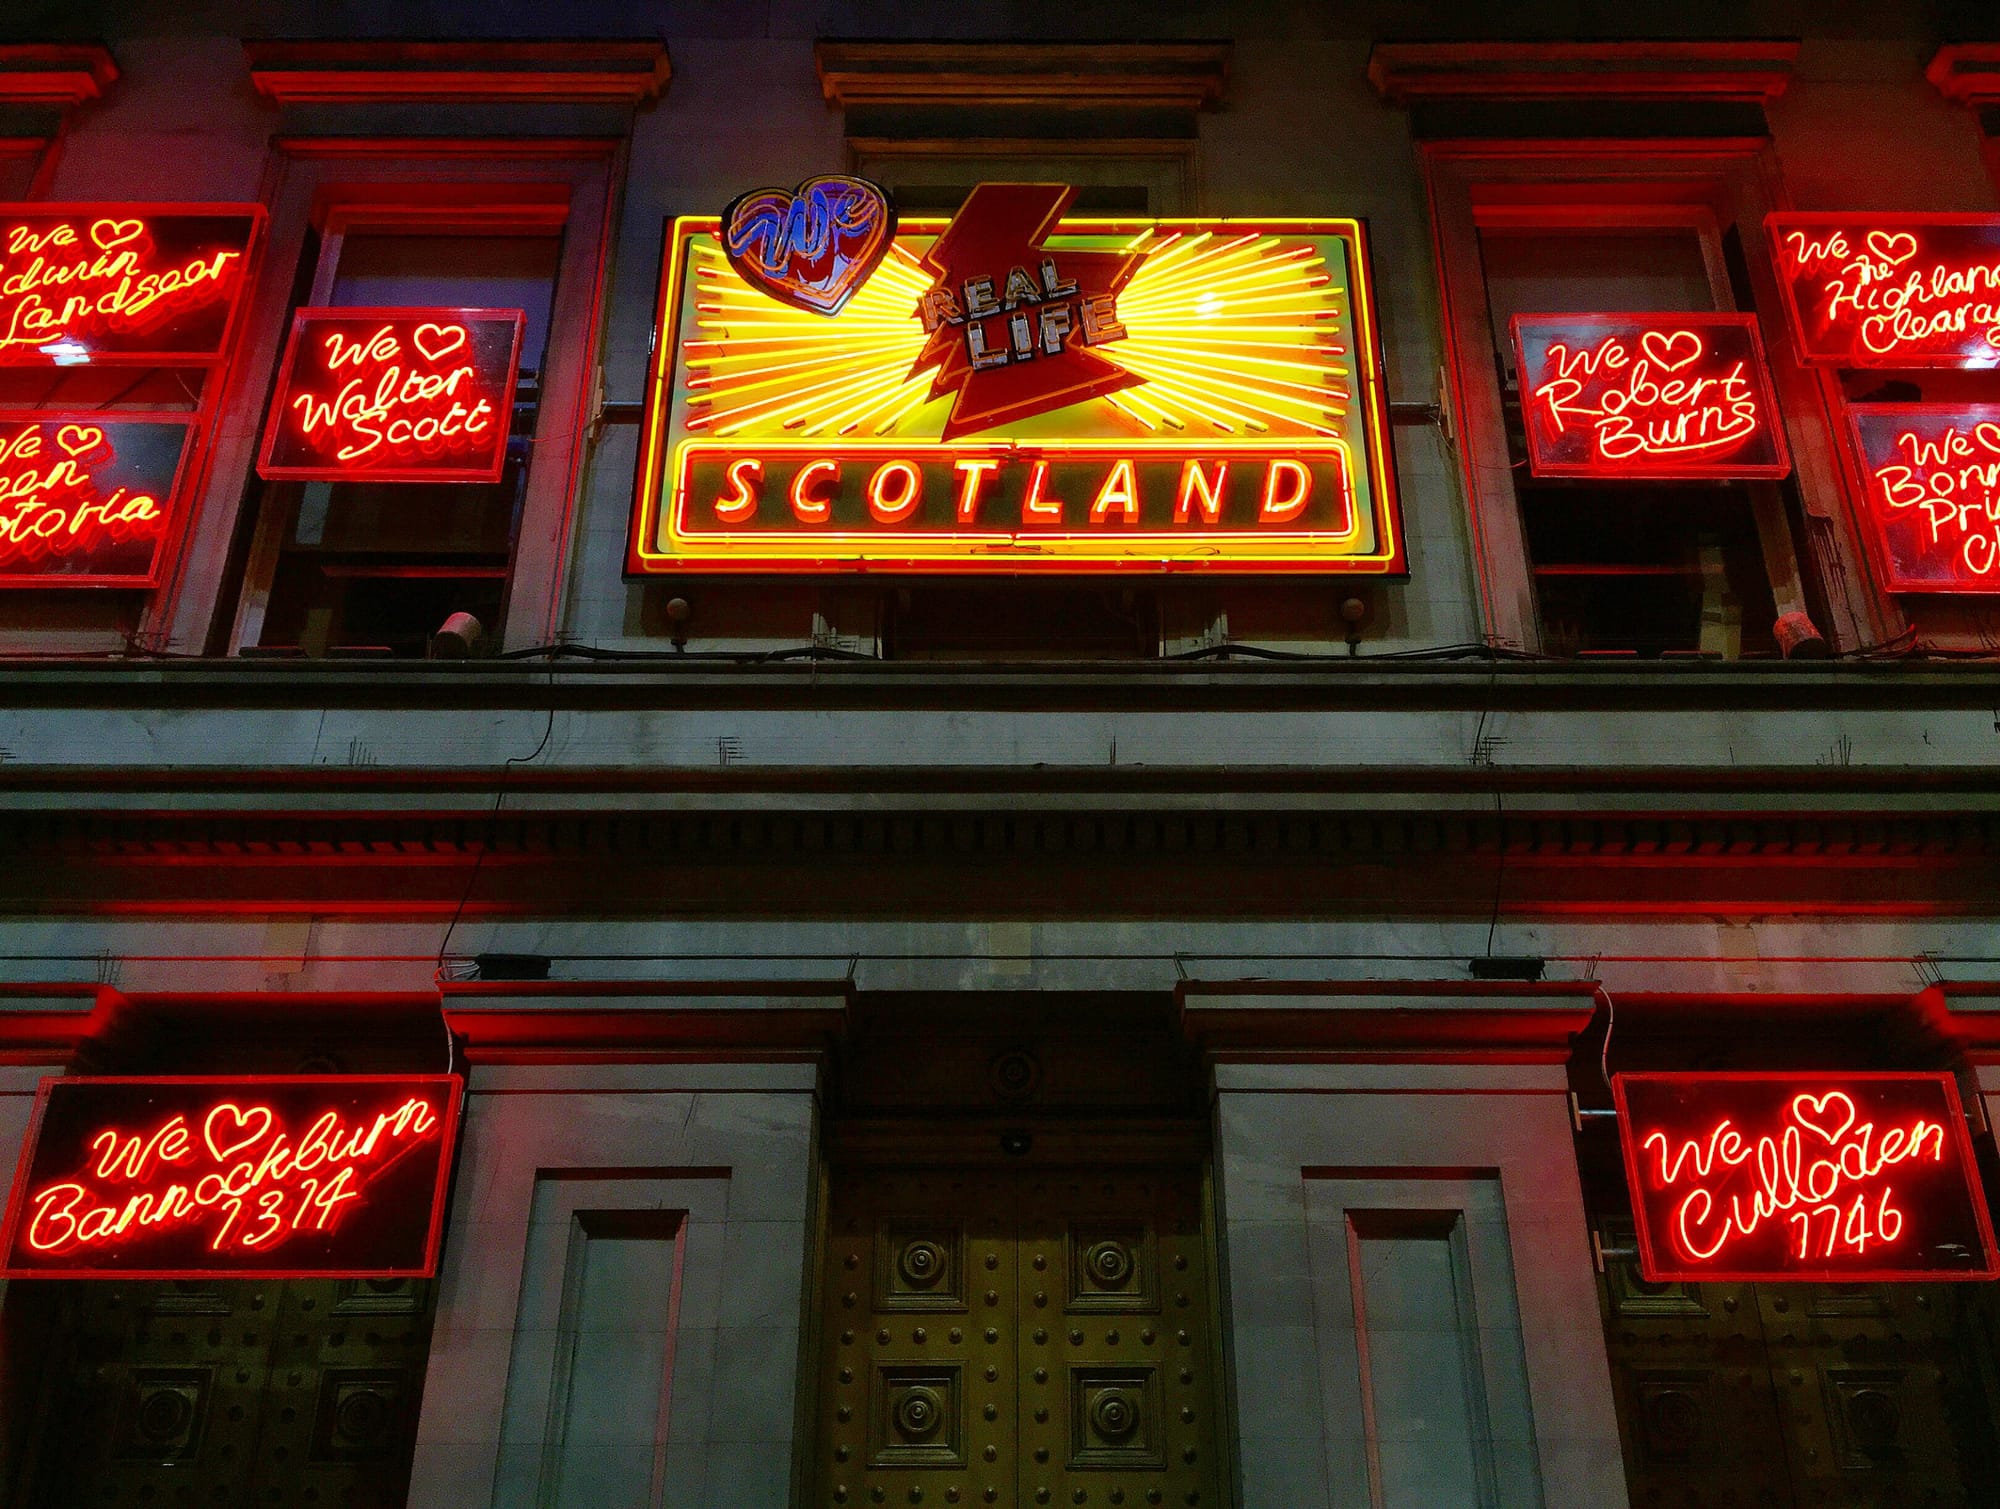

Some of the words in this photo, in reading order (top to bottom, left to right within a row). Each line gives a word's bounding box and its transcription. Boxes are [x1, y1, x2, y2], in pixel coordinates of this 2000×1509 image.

[8, 223, 78, 254] We
[1787, 230, 1850, 264] We
[917, 256, 1082, 333] REAL
[324, 324, 402, 369] We
[966, 292, 1130, 371] LIFE
[1548, 337, 1630, 378] We
[1862, 303, 2000, 353] Cleara
[293, 365, 473, 433] Walter
[1535, 359, 1752, 433] Robert
[336, 399, 492, 460] Scott
[1594, 401, 1756, 459] Burns
[1898, 427, 1975, 466] We
[713, 458, 1314, 525] SCOTLAND
[28, 1098, 437, 1250] Bannockburn
[93, 1115, 191, 1179] We
[1643, 1119, 1754, 1183] We
[212, 1166, 358, 1250] 1314
[1679, 1119, 1944, 1259] Culloden
[1790, 1186, 1903, 1259] 1746
